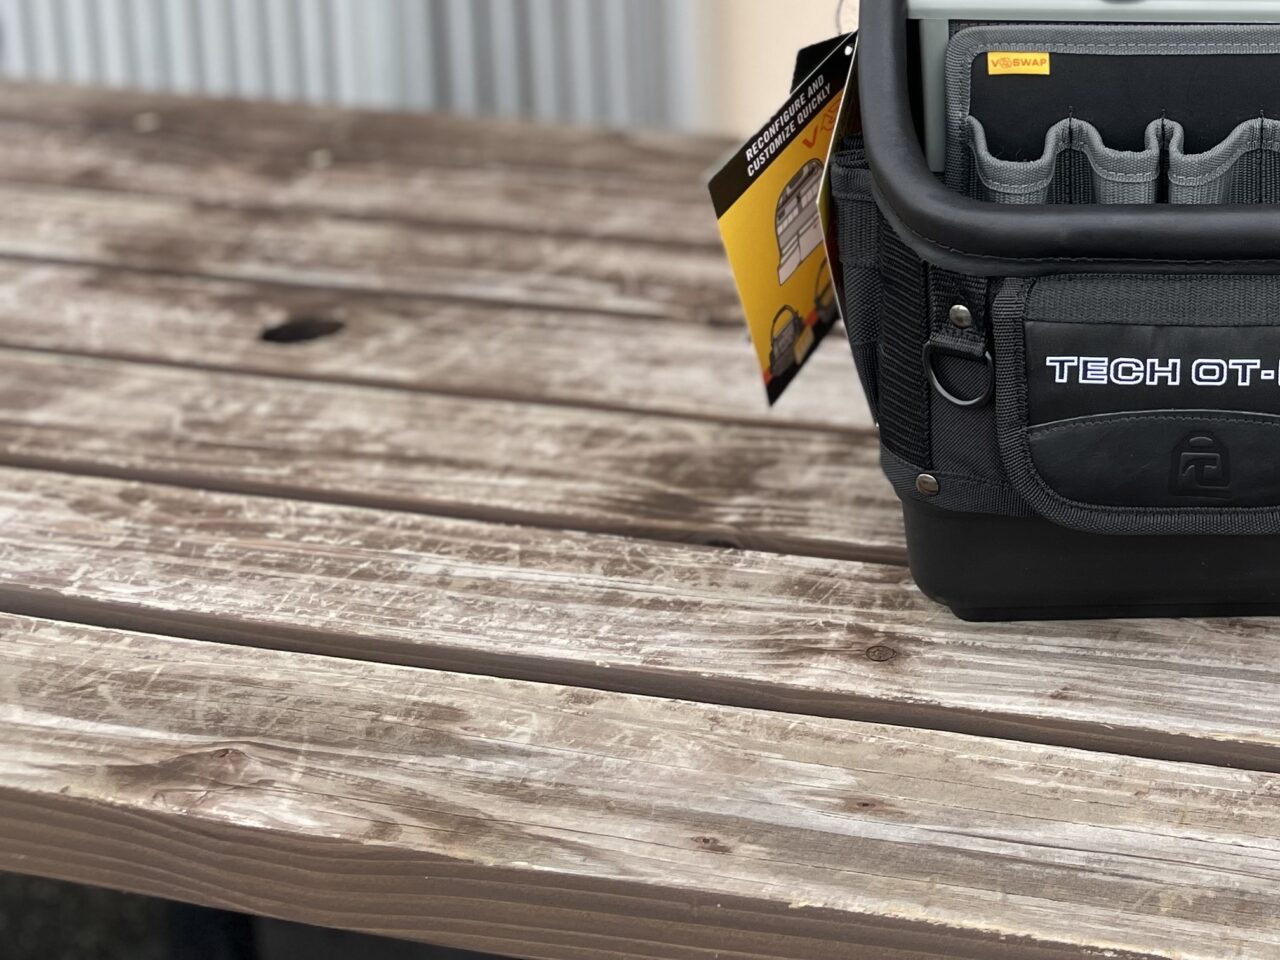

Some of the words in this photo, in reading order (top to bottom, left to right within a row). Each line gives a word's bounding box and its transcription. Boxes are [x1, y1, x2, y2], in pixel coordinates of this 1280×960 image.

[745, 93, 807, 162] RECONFIGURE
[807, 74, 825, 98] AND
[747, 120, 796, 177] CUSTOMIZE
[796, 82, 831, 125] QUICKLY
[1045, 356, 1182, 386] TECH
